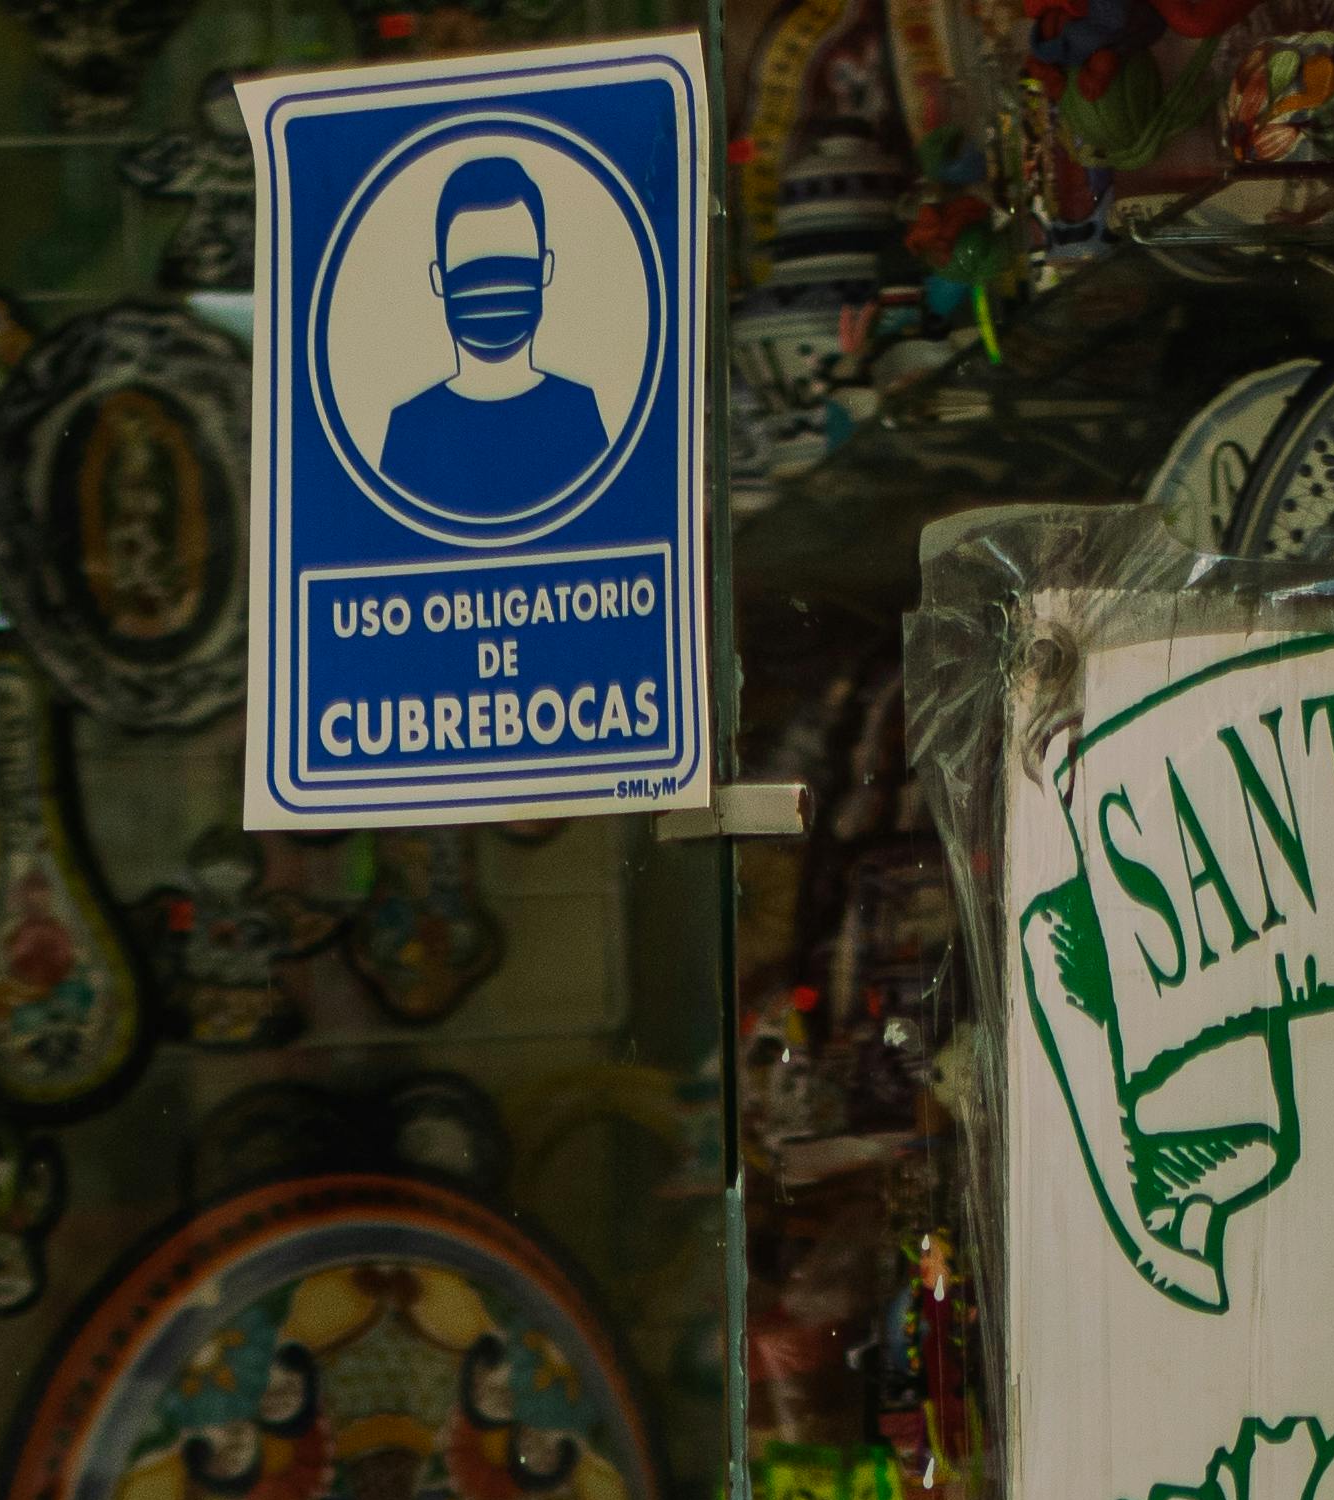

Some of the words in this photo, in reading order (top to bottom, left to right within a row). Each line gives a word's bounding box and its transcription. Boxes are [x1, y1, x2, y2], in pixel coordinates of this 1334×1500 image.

[333, 596, 410, 638] USO
[424, 578, 655, 631] OBLIGATORIO
[478, 640, 517, 679] DE
[320, 683, 658, 758] CUBREBOCAS
